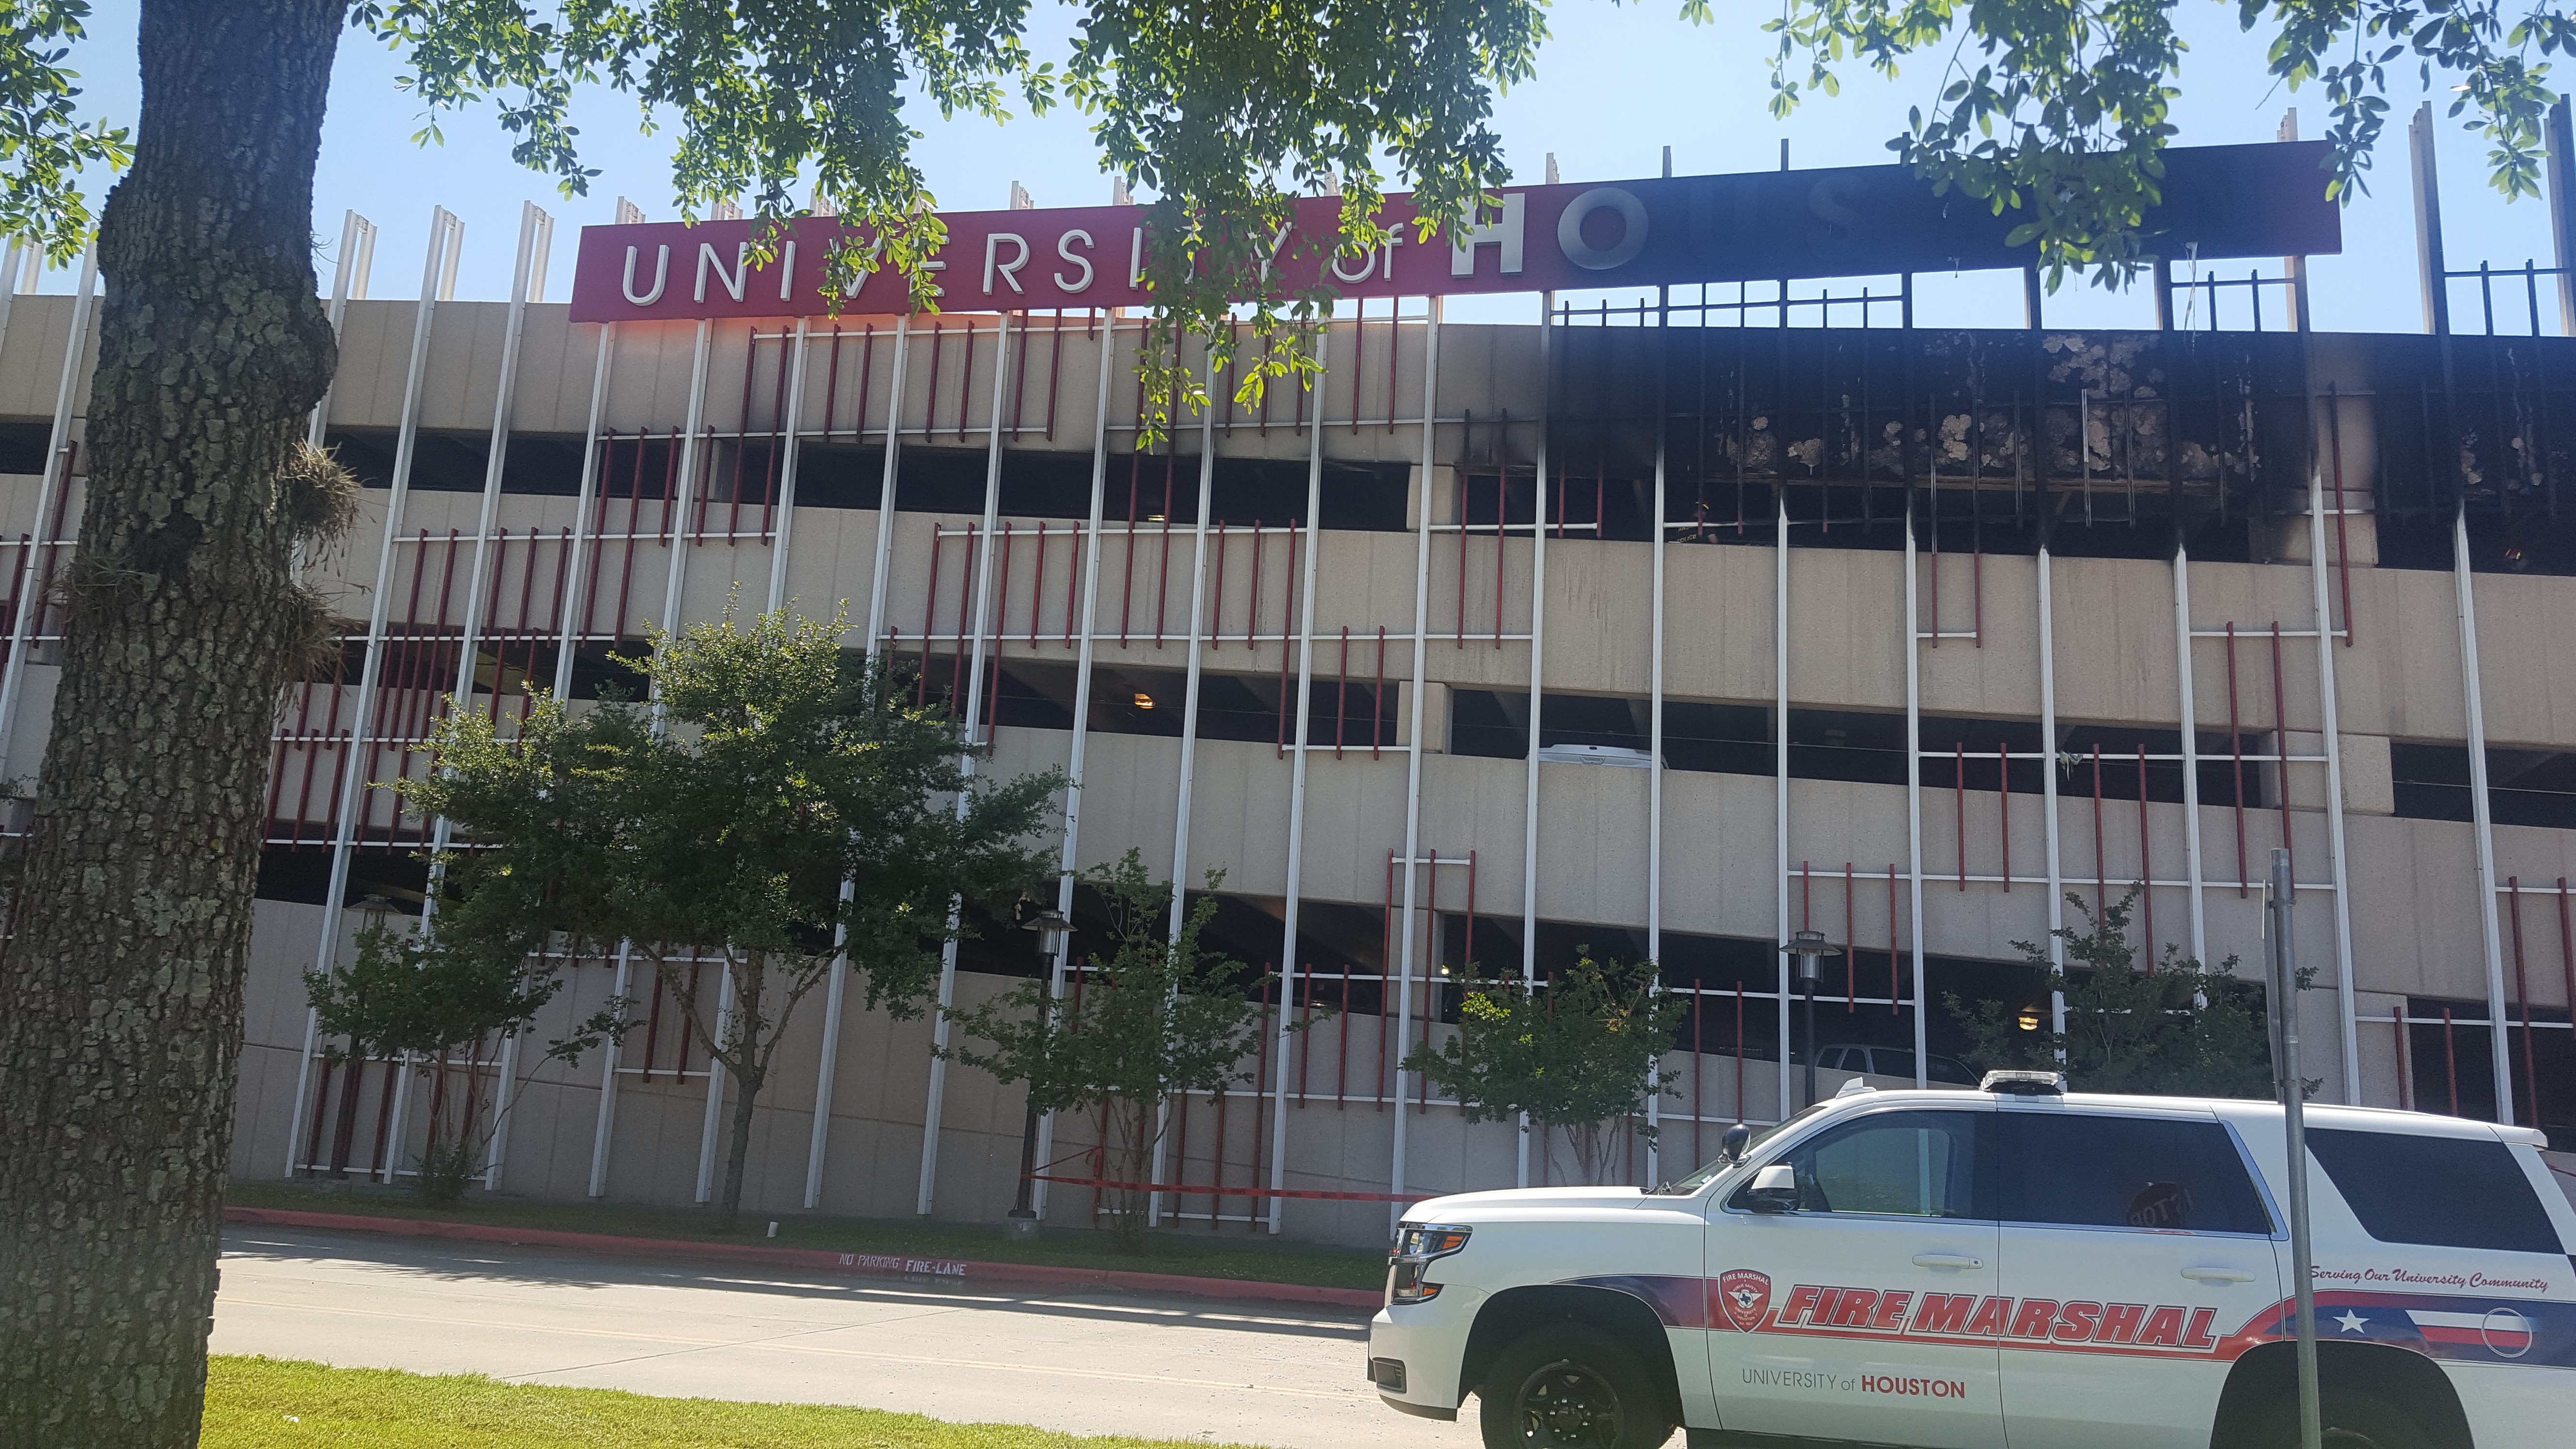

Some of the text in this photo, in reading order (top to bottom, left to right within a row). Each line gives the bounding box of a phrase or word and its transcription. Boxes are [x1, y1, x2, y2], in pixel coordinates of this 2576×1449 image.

[623, 221, 1293, 306] UNIVERSIY
[1332, 222, 1405, 284] of
[839, 1254, 853, 1265] NO
[858, 1255, 900, 1268] PARKING
[1722, 1272, 1769, 1286] FIRE MARSHAL
[2311, 1265, 2549, 1293] Serving Our University Community
[1735, 1306, 1757, 1315] UNIVERSITY
[1778, 1284, 2218, 1350] FIRE MARSHAL
[1742, 1368, 1965, 1399] UNIVERSITY of HOUSTON
